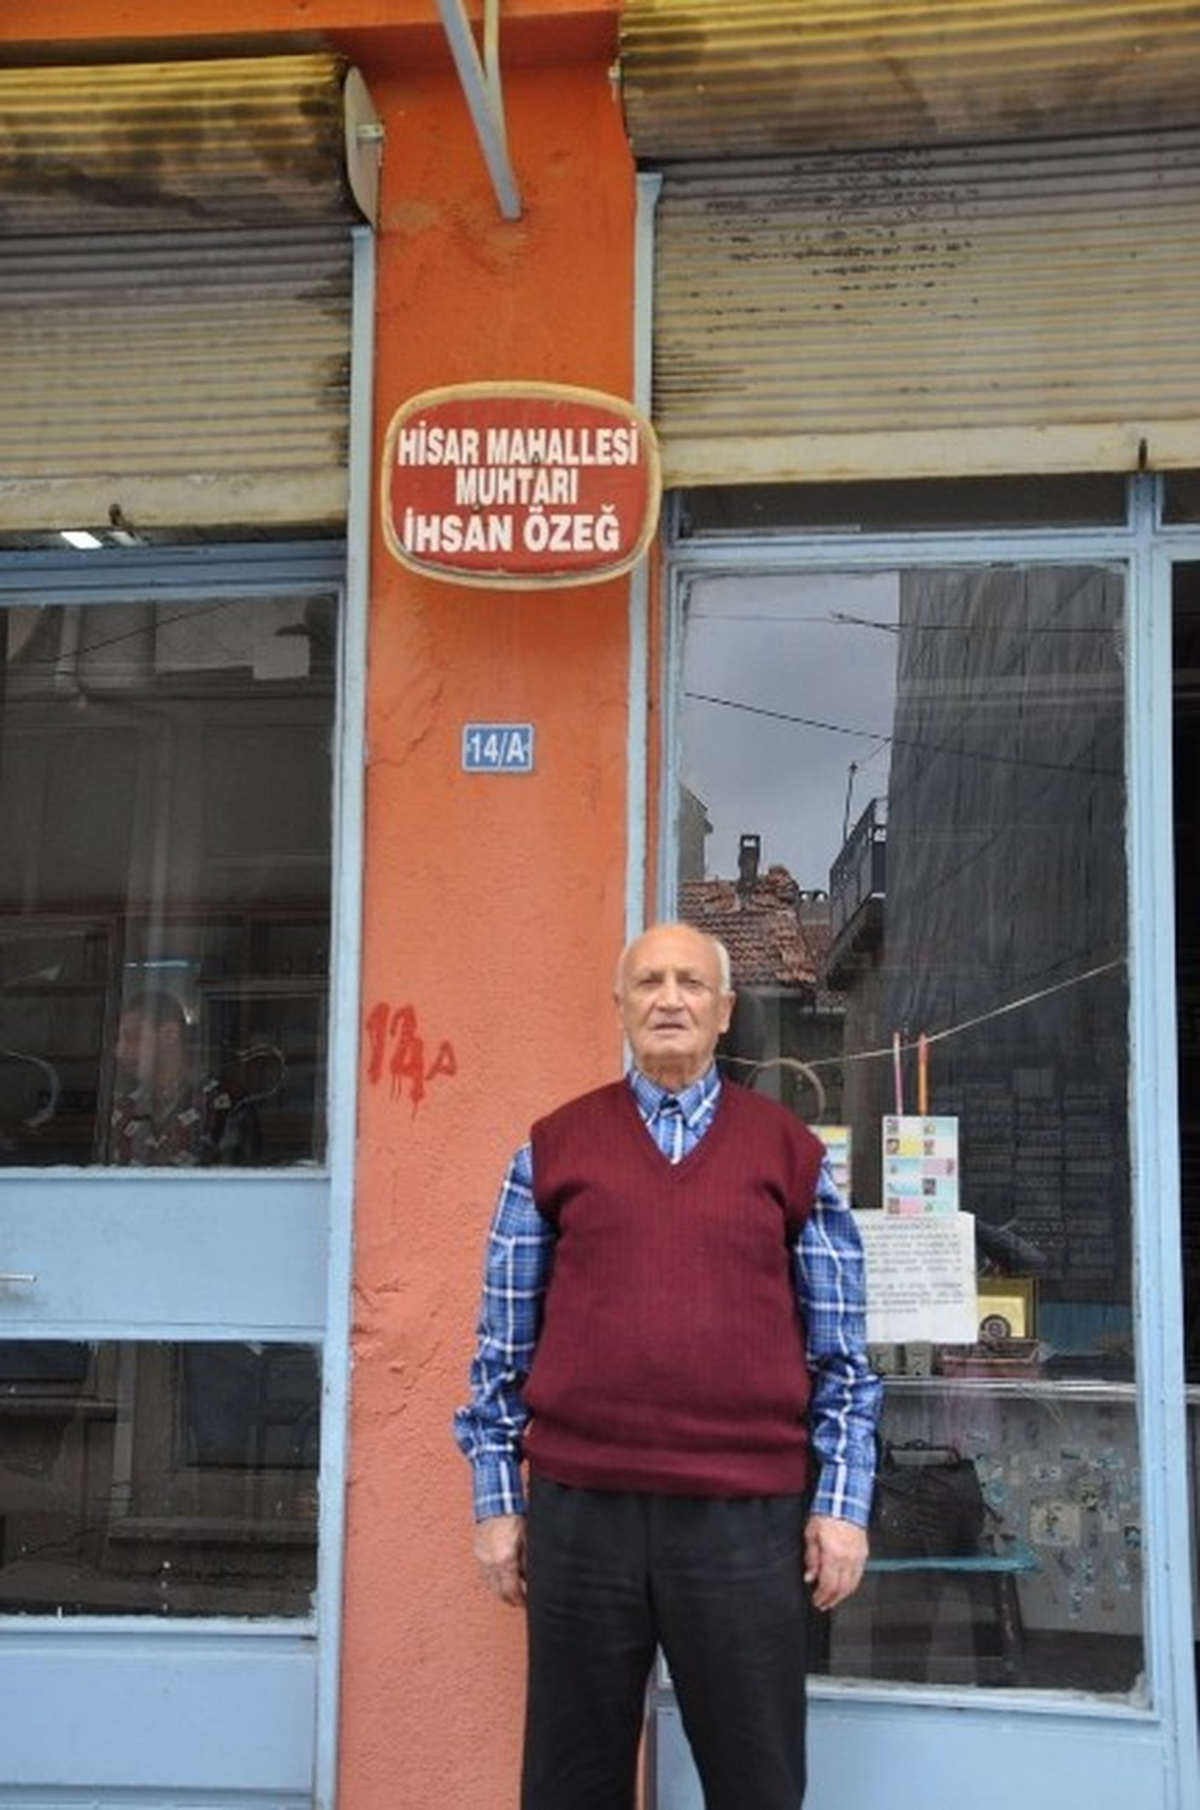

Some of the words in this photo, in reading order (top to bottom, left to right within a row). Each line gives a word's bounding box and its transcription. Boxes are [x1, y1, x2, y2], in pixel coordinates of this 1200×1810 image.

[398, 421, 479, 466] HİSAR
[486, 421, 638, 466] MAHALLESİ
[455, 468, 578, 505] MUHTARI
[404, 507, 512, 552] İHSAN
[523, 505, 620, 551] ÖZEĞ
[469, 731, 525, 767] 14/A
